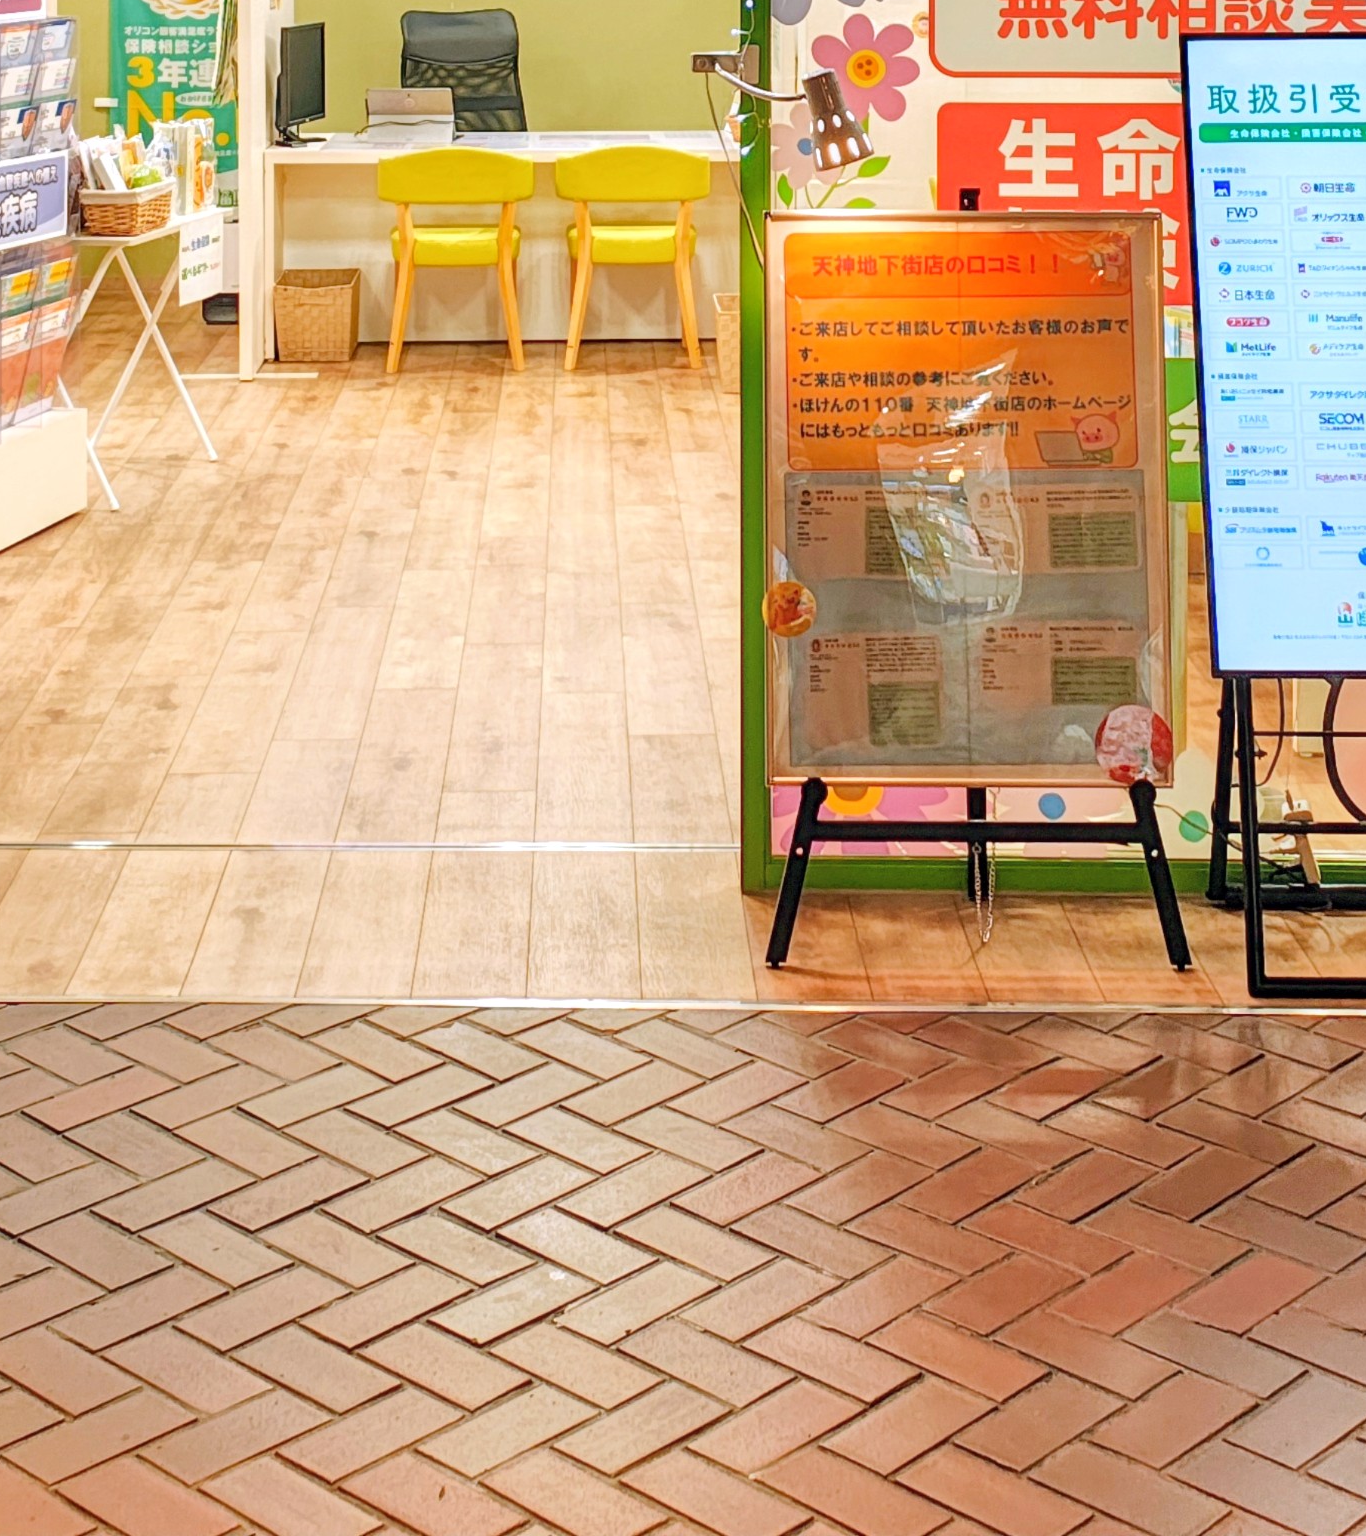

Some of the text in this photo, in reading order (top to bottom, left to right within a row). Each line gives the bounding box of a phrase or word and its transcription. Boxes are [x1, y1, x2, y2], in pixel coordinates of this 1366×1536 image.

[997, 117, 1182, 201] 生命
[1234, 289, 1276, 301] 日本生命
[1240, 342, 1277, 352] MetLife
[1318, 412, 1365, 425] SECOM
